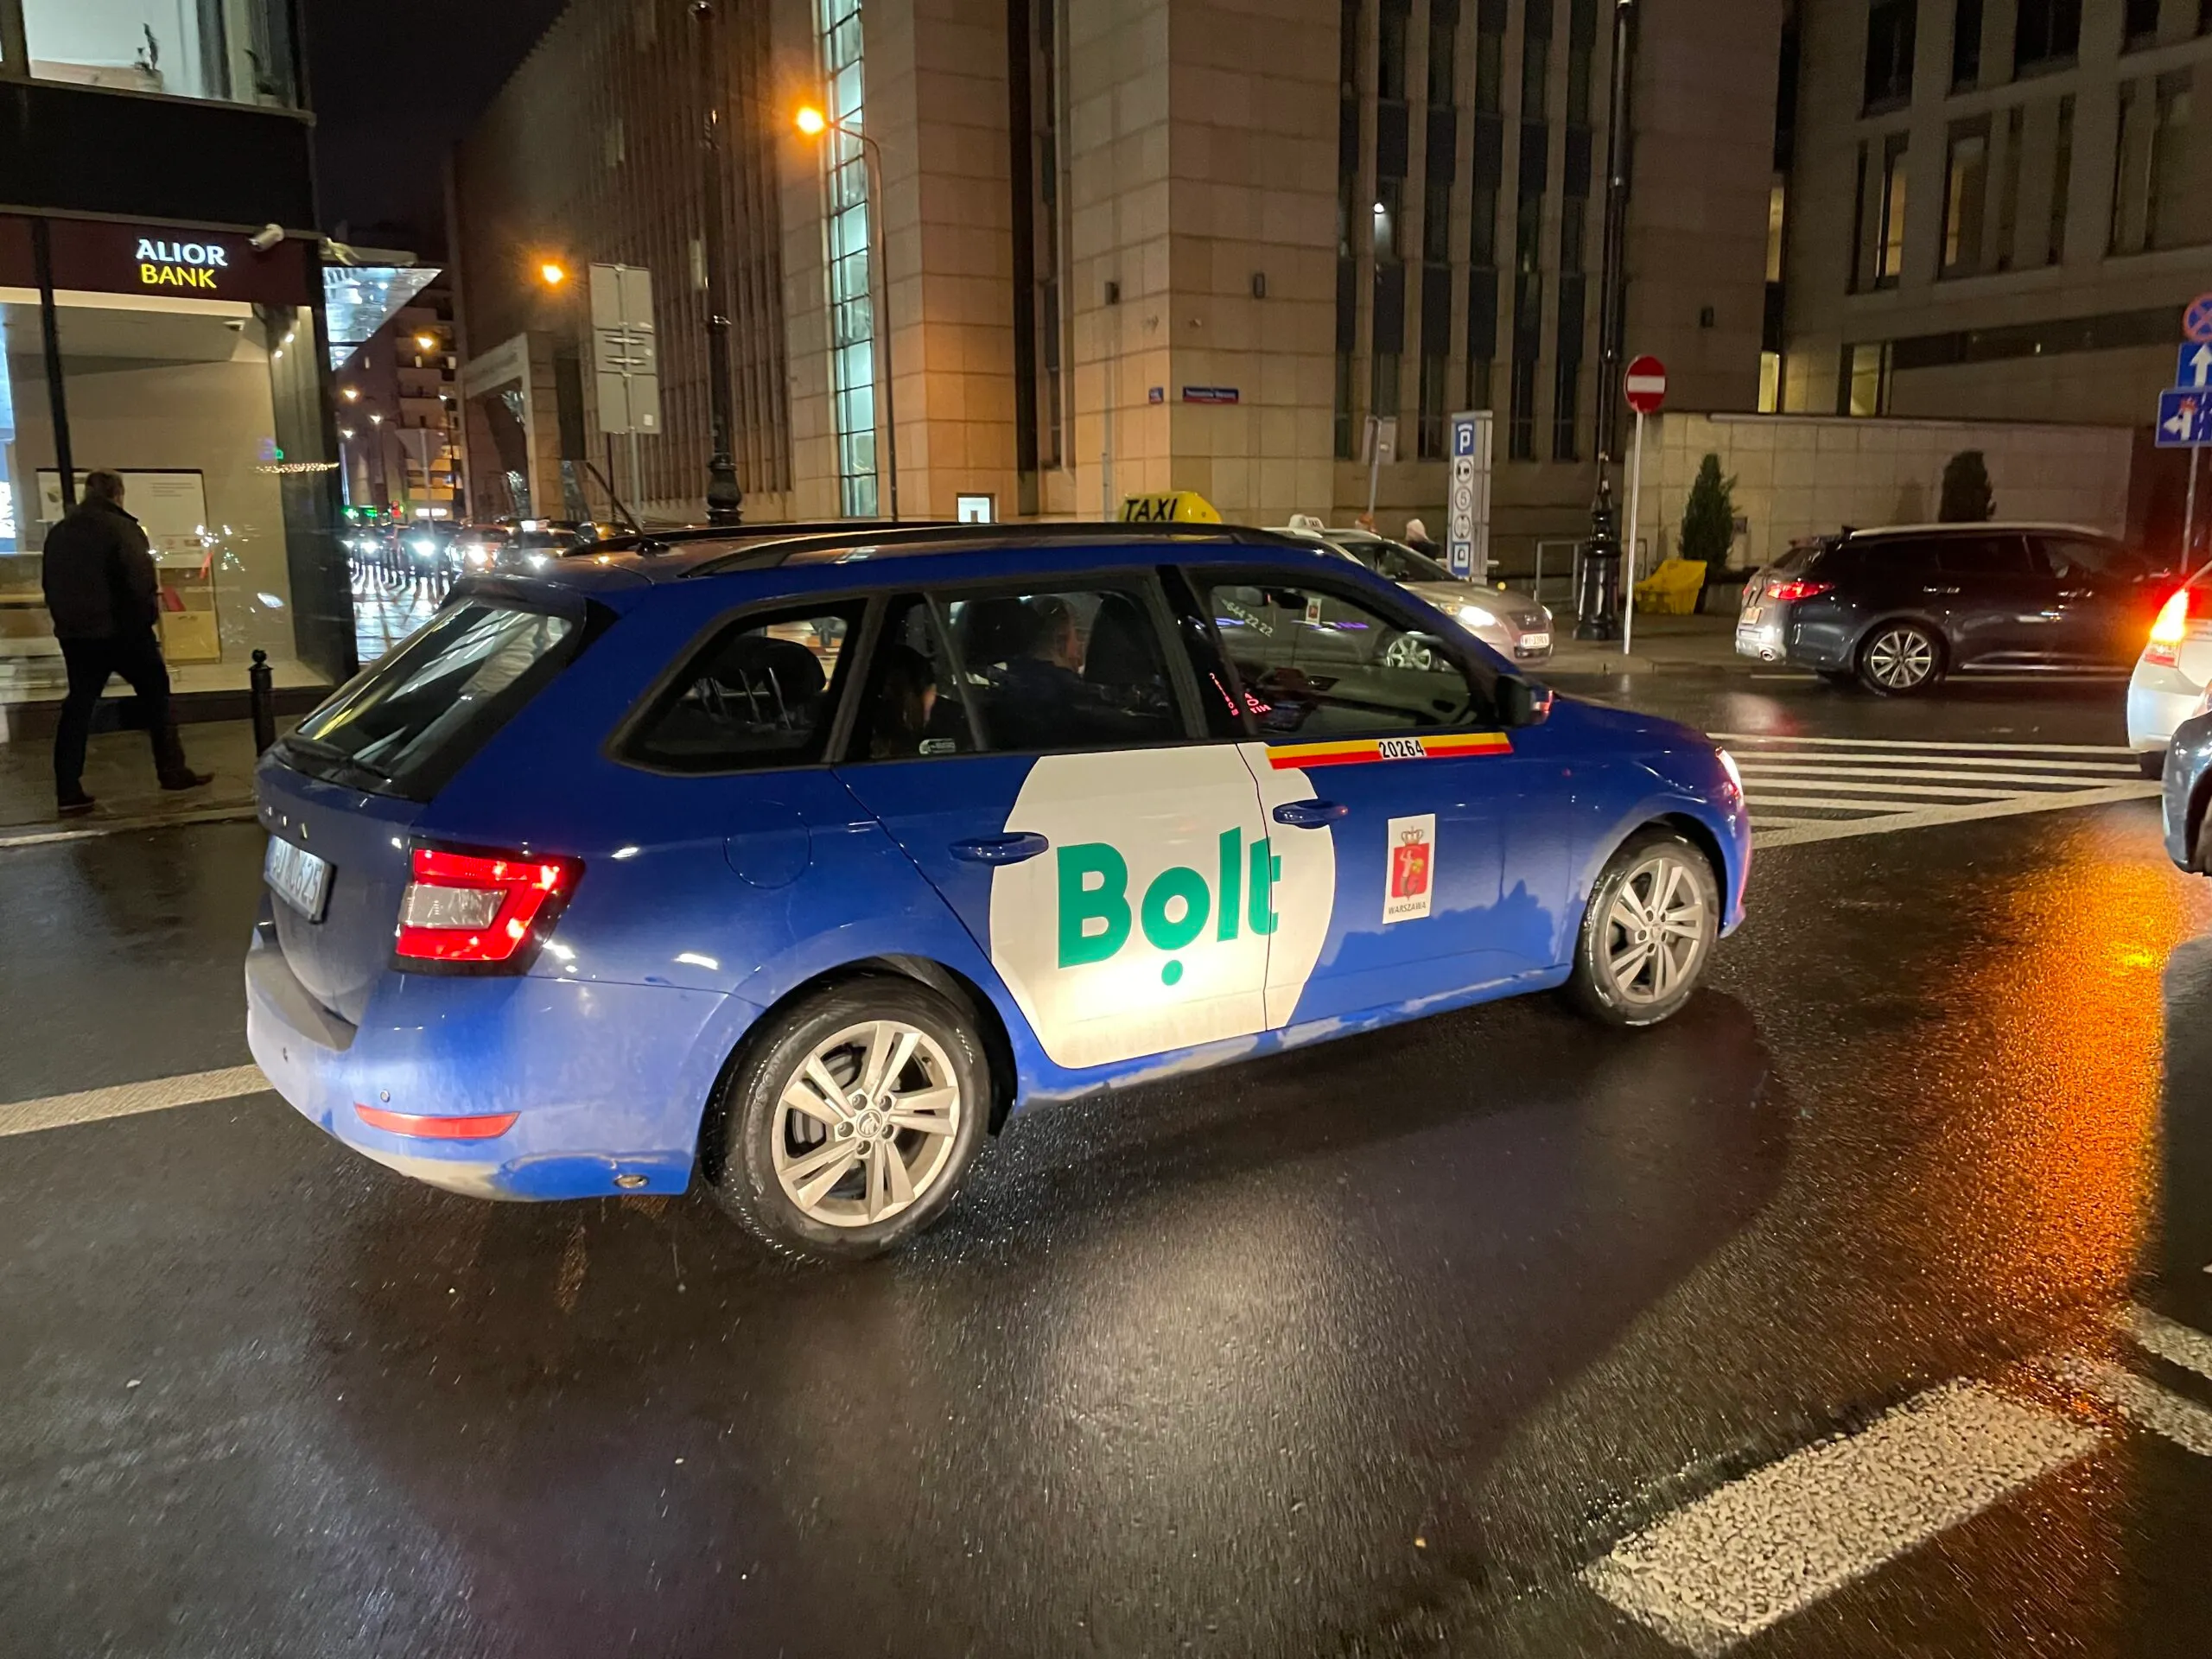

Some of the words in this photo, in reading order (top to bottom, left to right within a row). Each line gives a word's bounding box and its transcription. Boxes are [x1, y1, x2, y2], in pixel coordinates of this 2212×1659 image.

[136, 238, 228, 266] ALIOR
[141, 264, 217, 289] BANK
[1459, 431, 1471, 454] P
[1125, 499, 1178, 522] TAXI
[1378, 740, 1425, 758] 20264
[1057, 826, 1281, 986] Bolt
[1389, 901, 1427, 916] WARSZAWA
